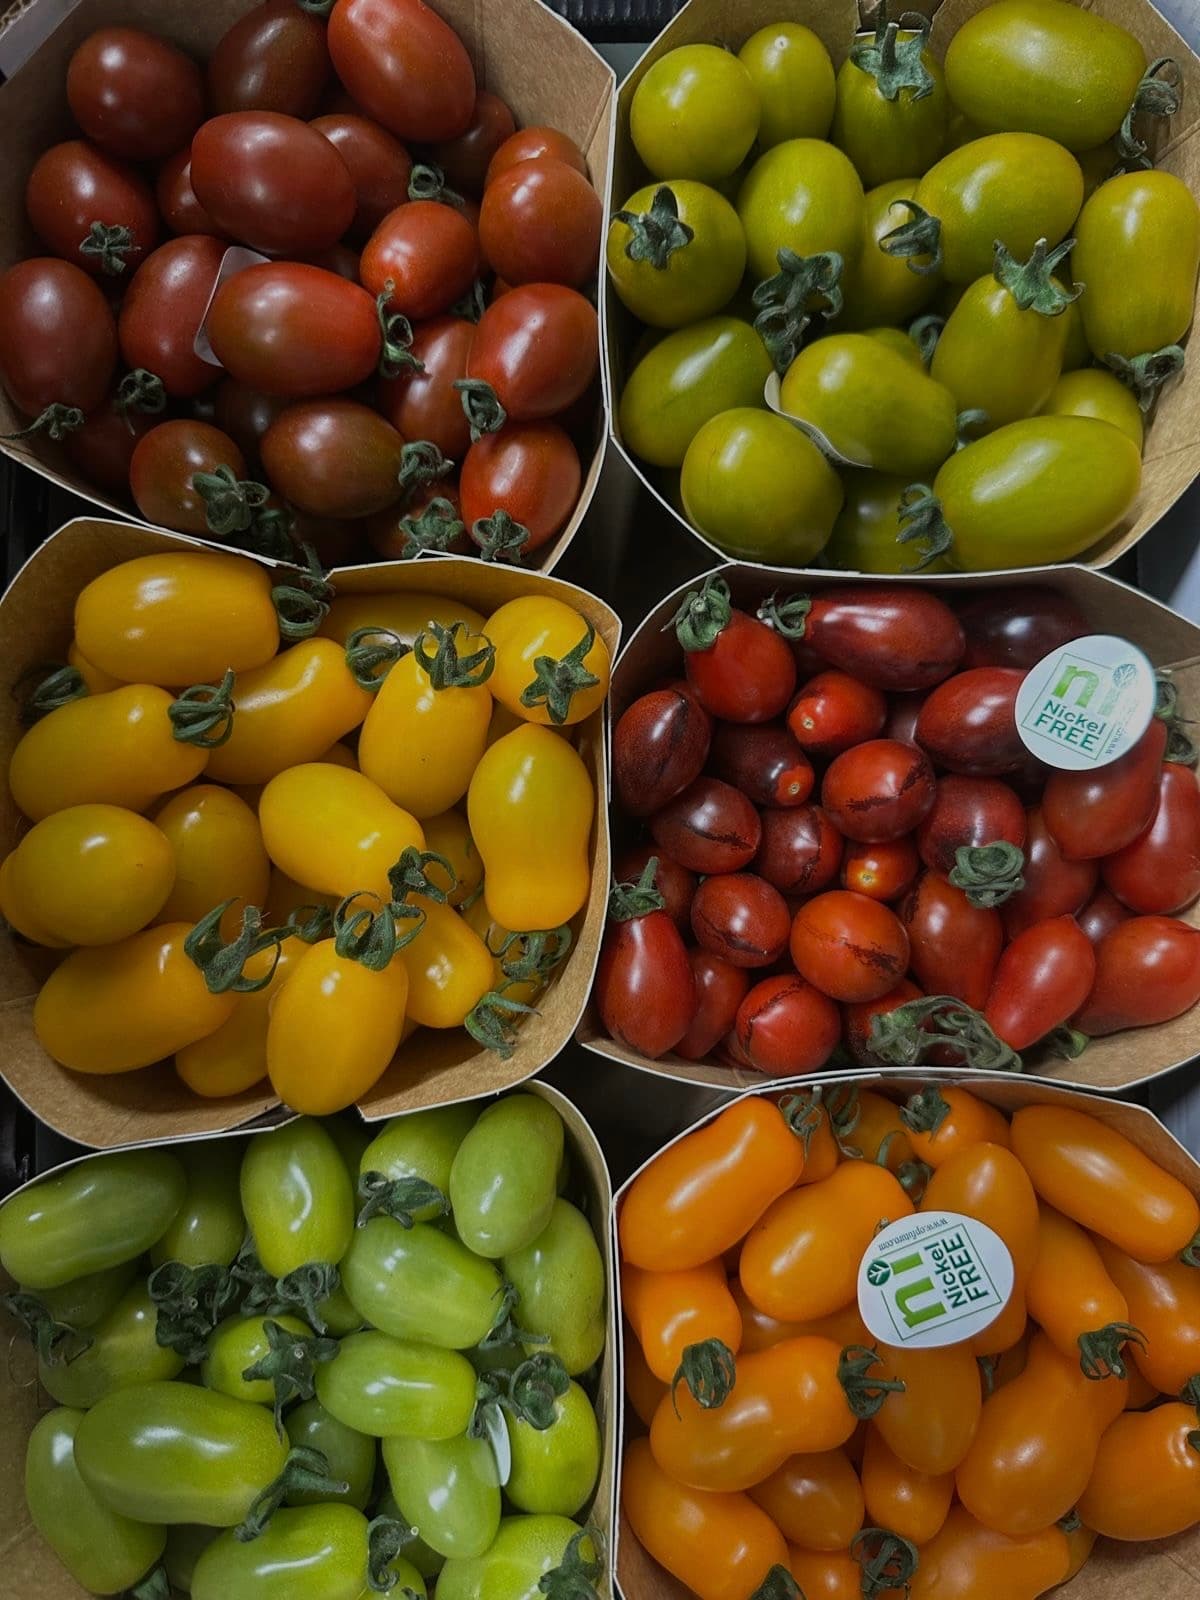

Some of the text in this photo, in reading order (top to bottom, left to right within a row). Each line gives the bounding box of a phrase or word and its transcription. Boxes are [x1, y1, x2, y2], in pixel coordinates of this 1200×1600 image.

[1034, 713, 1099, 752] FREE
[1043, 699, 1108, 735] Nickel
[924, 1242, 968, 1309] Nickel
[942, 1232, 990, 1302] FREE
